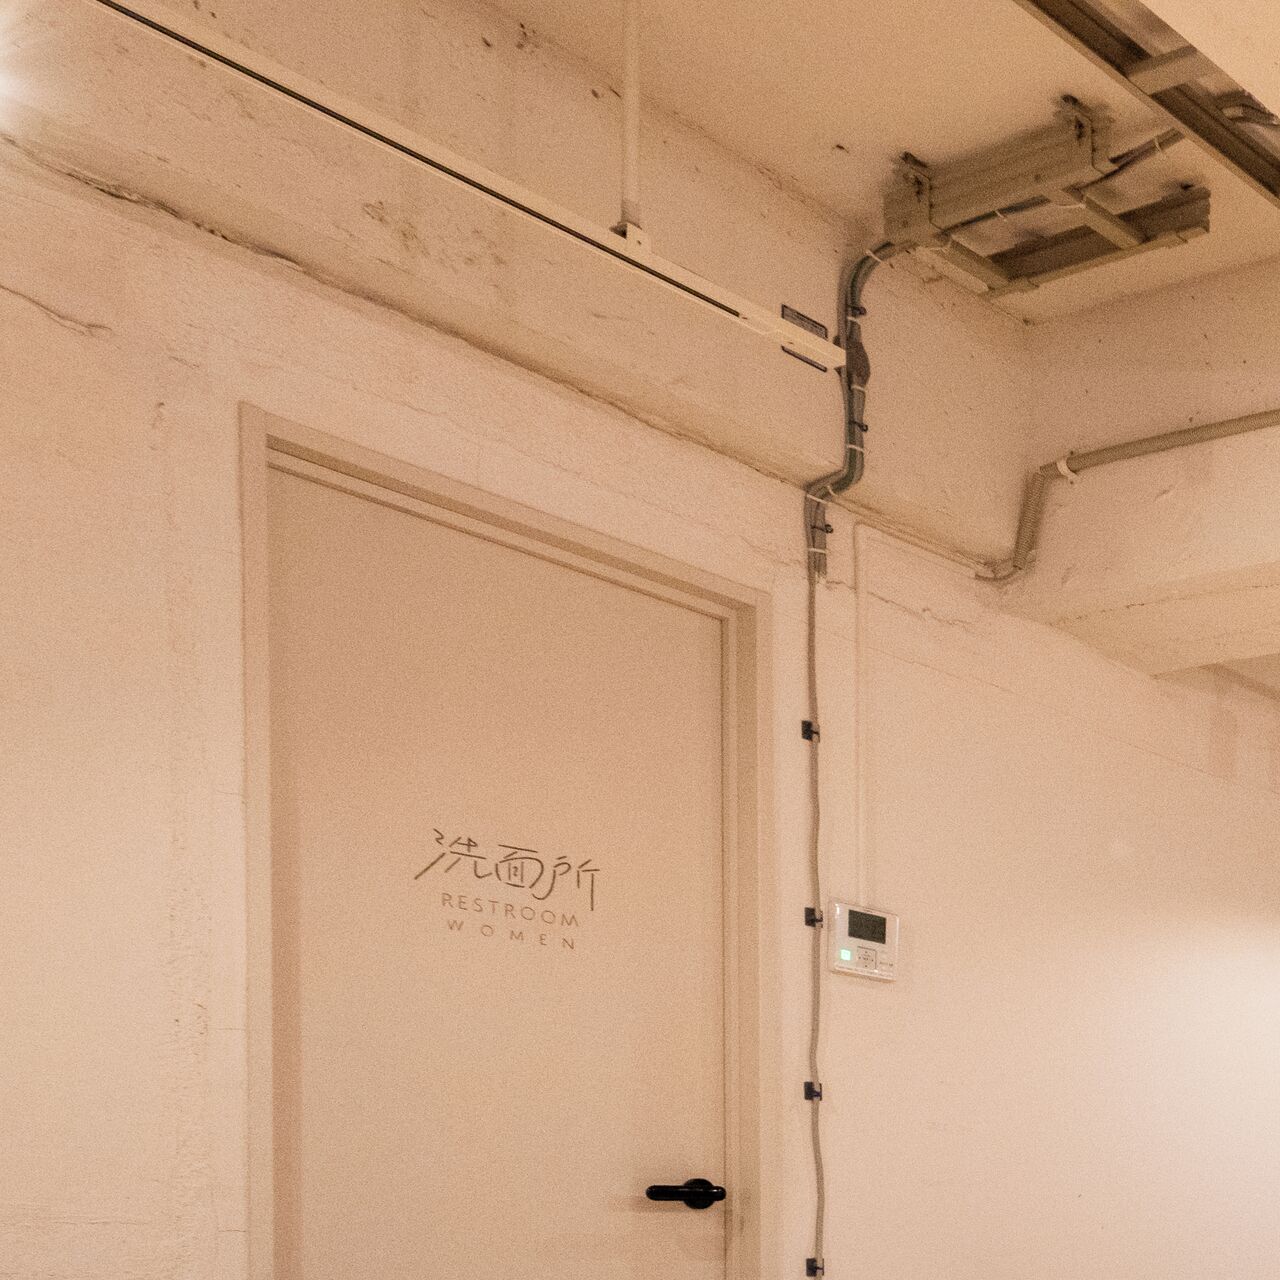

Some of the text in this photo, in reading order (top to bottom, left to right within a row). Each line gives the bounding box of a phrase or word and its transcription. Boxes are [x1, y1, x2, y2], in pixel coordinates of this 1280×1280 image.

[414, 827, 601, 912] 洗面所
[441, 892, 579, 927] RESTROOM
[448, 919, 576, 950] WOMEN
